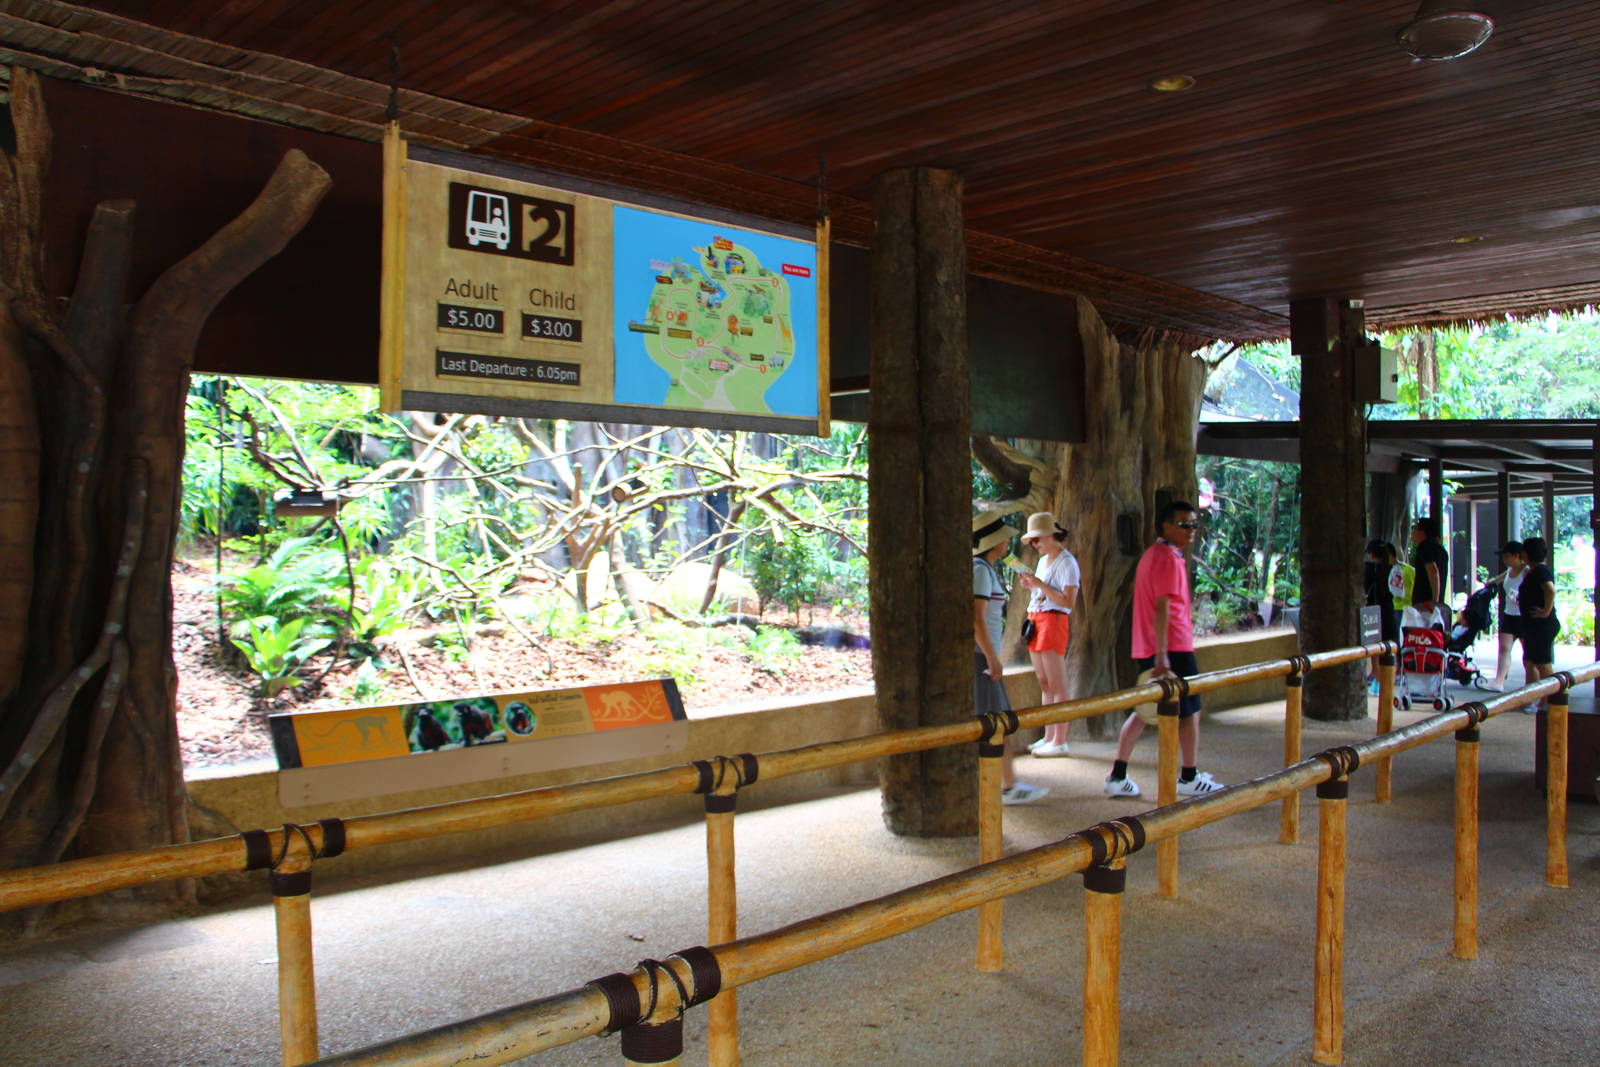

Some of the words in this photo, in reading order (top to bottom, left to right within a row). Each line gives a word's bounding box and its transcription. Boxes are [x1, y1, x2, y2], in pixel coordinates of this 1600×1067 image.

[528, 204, 563, 257] 2
[444, 277, 499, 302] Adult
[528, 288, 576, 311] Child
[447, 308, 496, 329] $5.00
[441, 357, 467, 372] Last
[469, 359, 528, 377] Departure
[536, 367, 577, 383] 6.05pm
[1408, 634, 1432, 645] FILA
